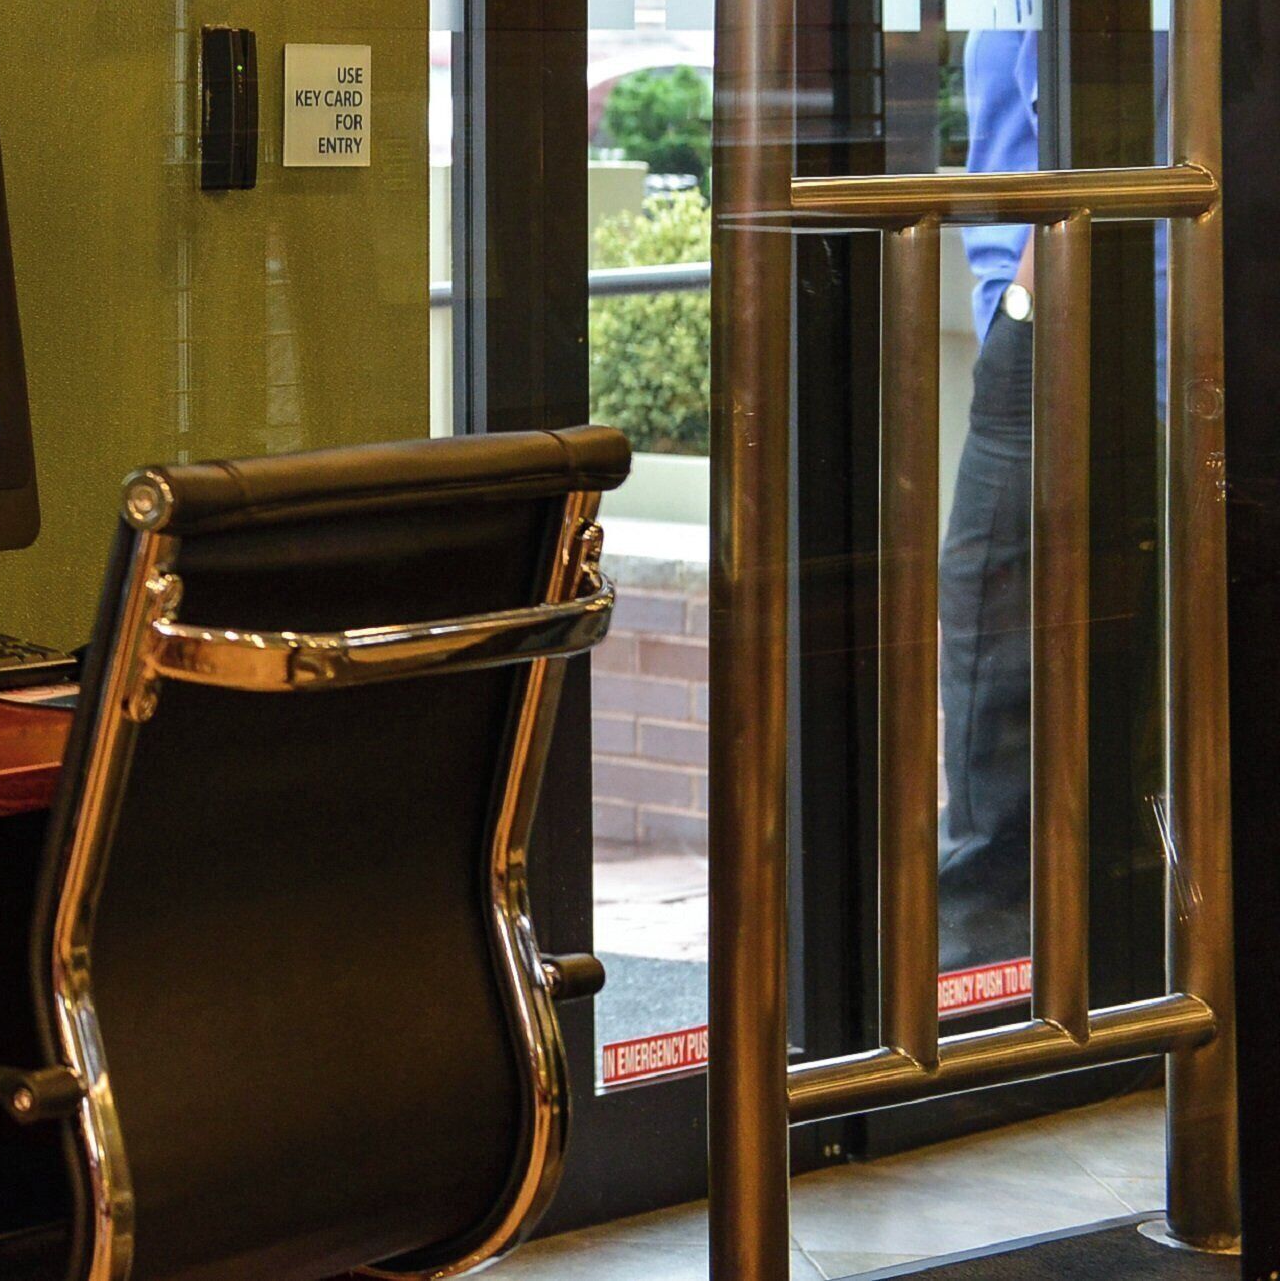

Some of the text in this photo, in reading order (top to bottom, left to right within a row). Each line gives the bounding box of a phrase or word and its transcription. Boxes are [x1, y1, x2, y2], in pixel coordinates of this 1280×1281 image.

[337, 67, 363, 84] USE
[295, 90, 363, 107] KEY CARD
[335, 113, 363, 130] FOR
[318, 137, 363, 153] ENTRY
[975, 969, 1003, 999] PUSH
[1005, 966, 1019, 994] TO
[603, 1048, 616, 1079] IN
[617, 1034, 686, 1075] EMERGENCY
